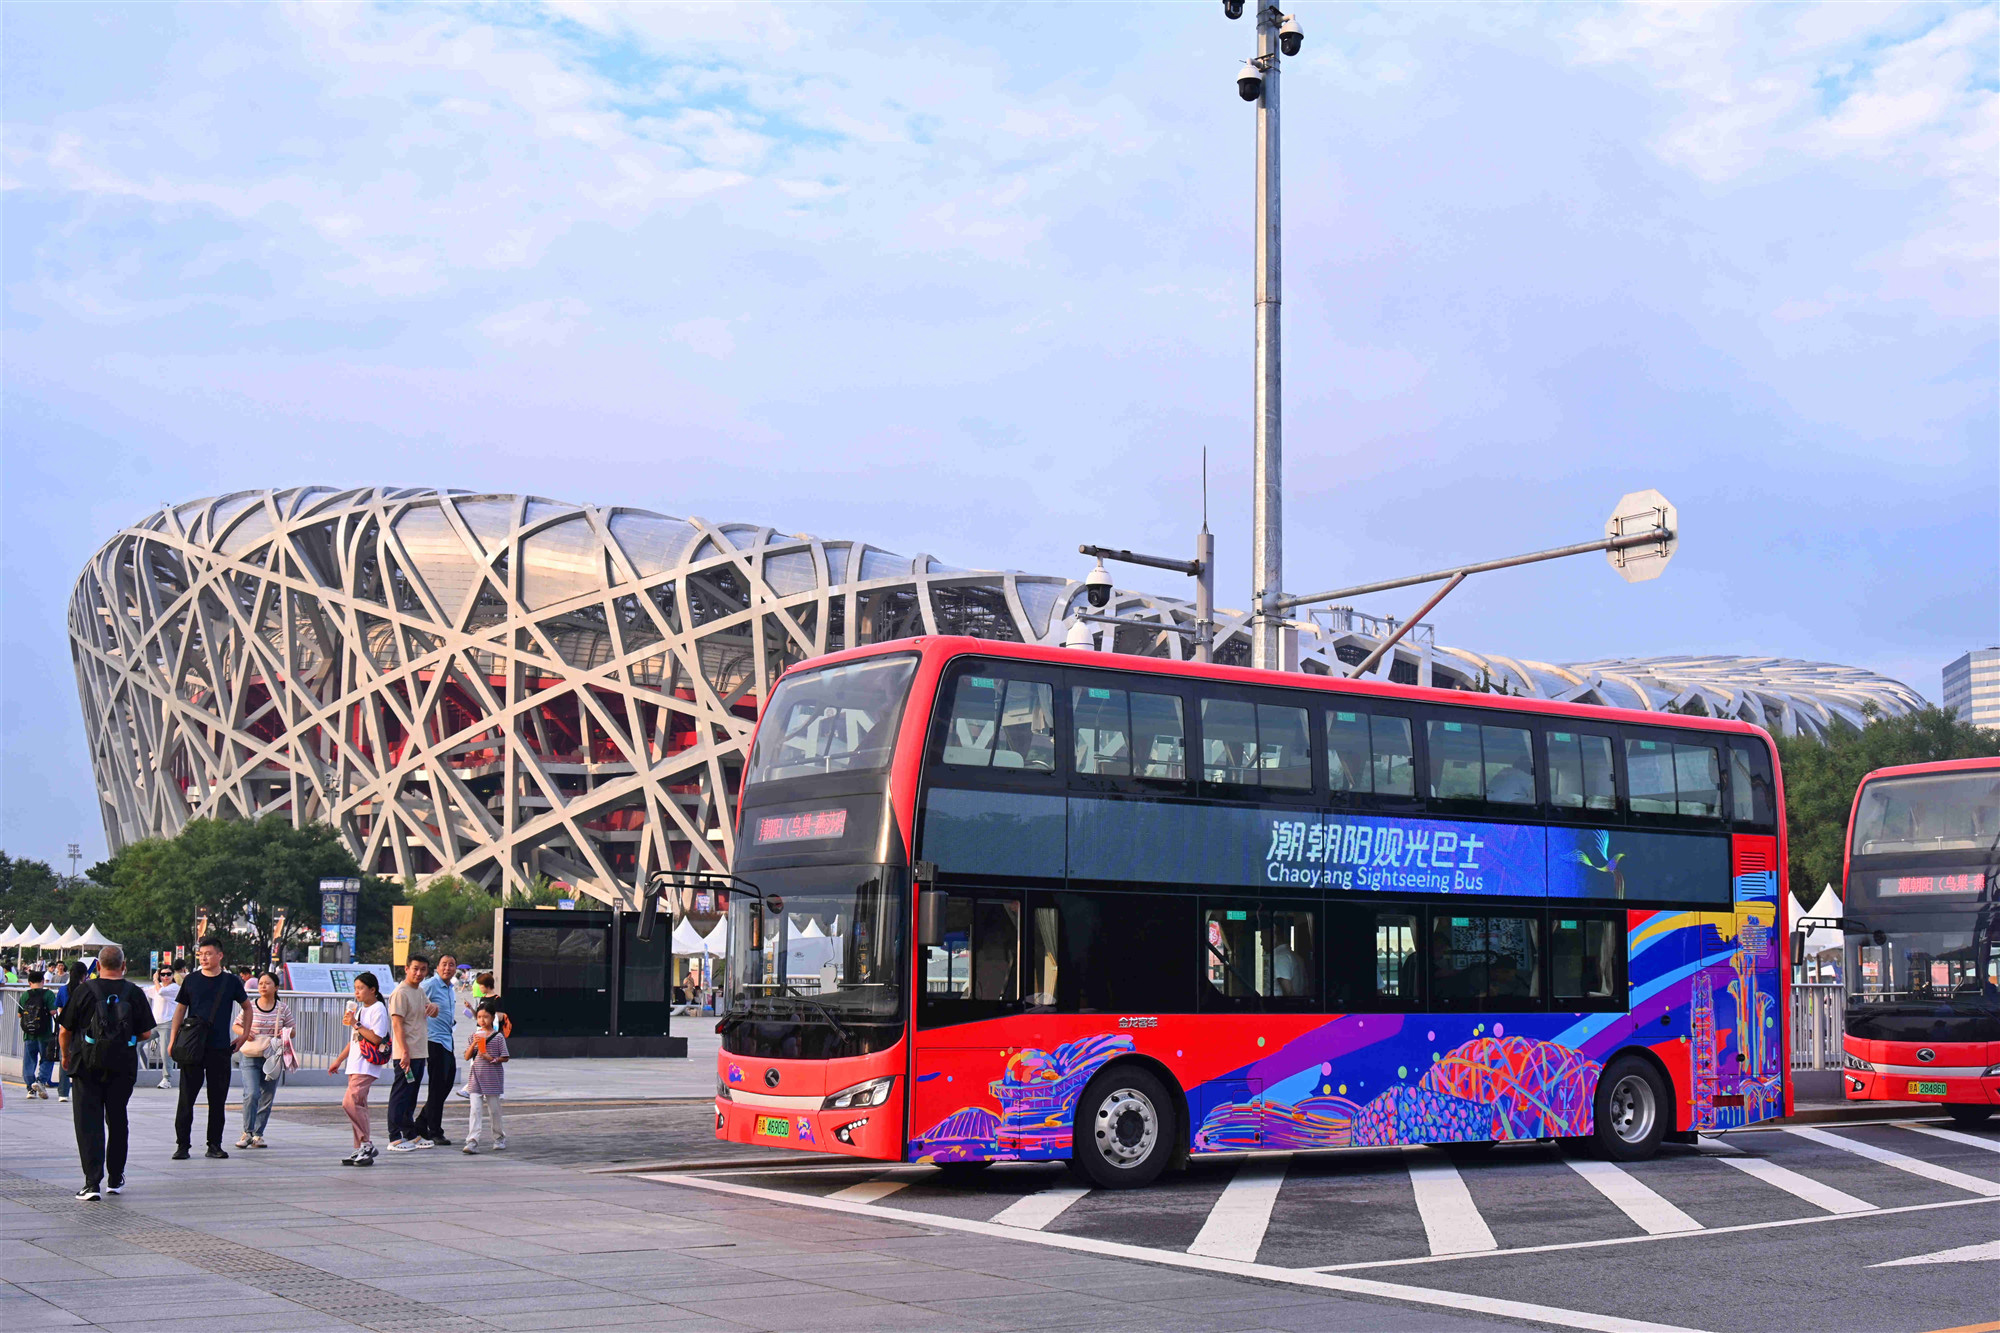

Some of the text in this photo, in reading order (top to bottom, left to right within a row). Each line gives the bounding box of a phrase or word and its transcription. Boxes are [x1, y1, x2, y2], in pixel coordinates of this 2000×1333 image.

[1266, 820, 1484, 869] 潮朝阳观光巴士
[1266, 862, 1484, 893] Chaoyang Sightseeing Bus
[1118, 1016, 1158, 1028] 金龙客车
